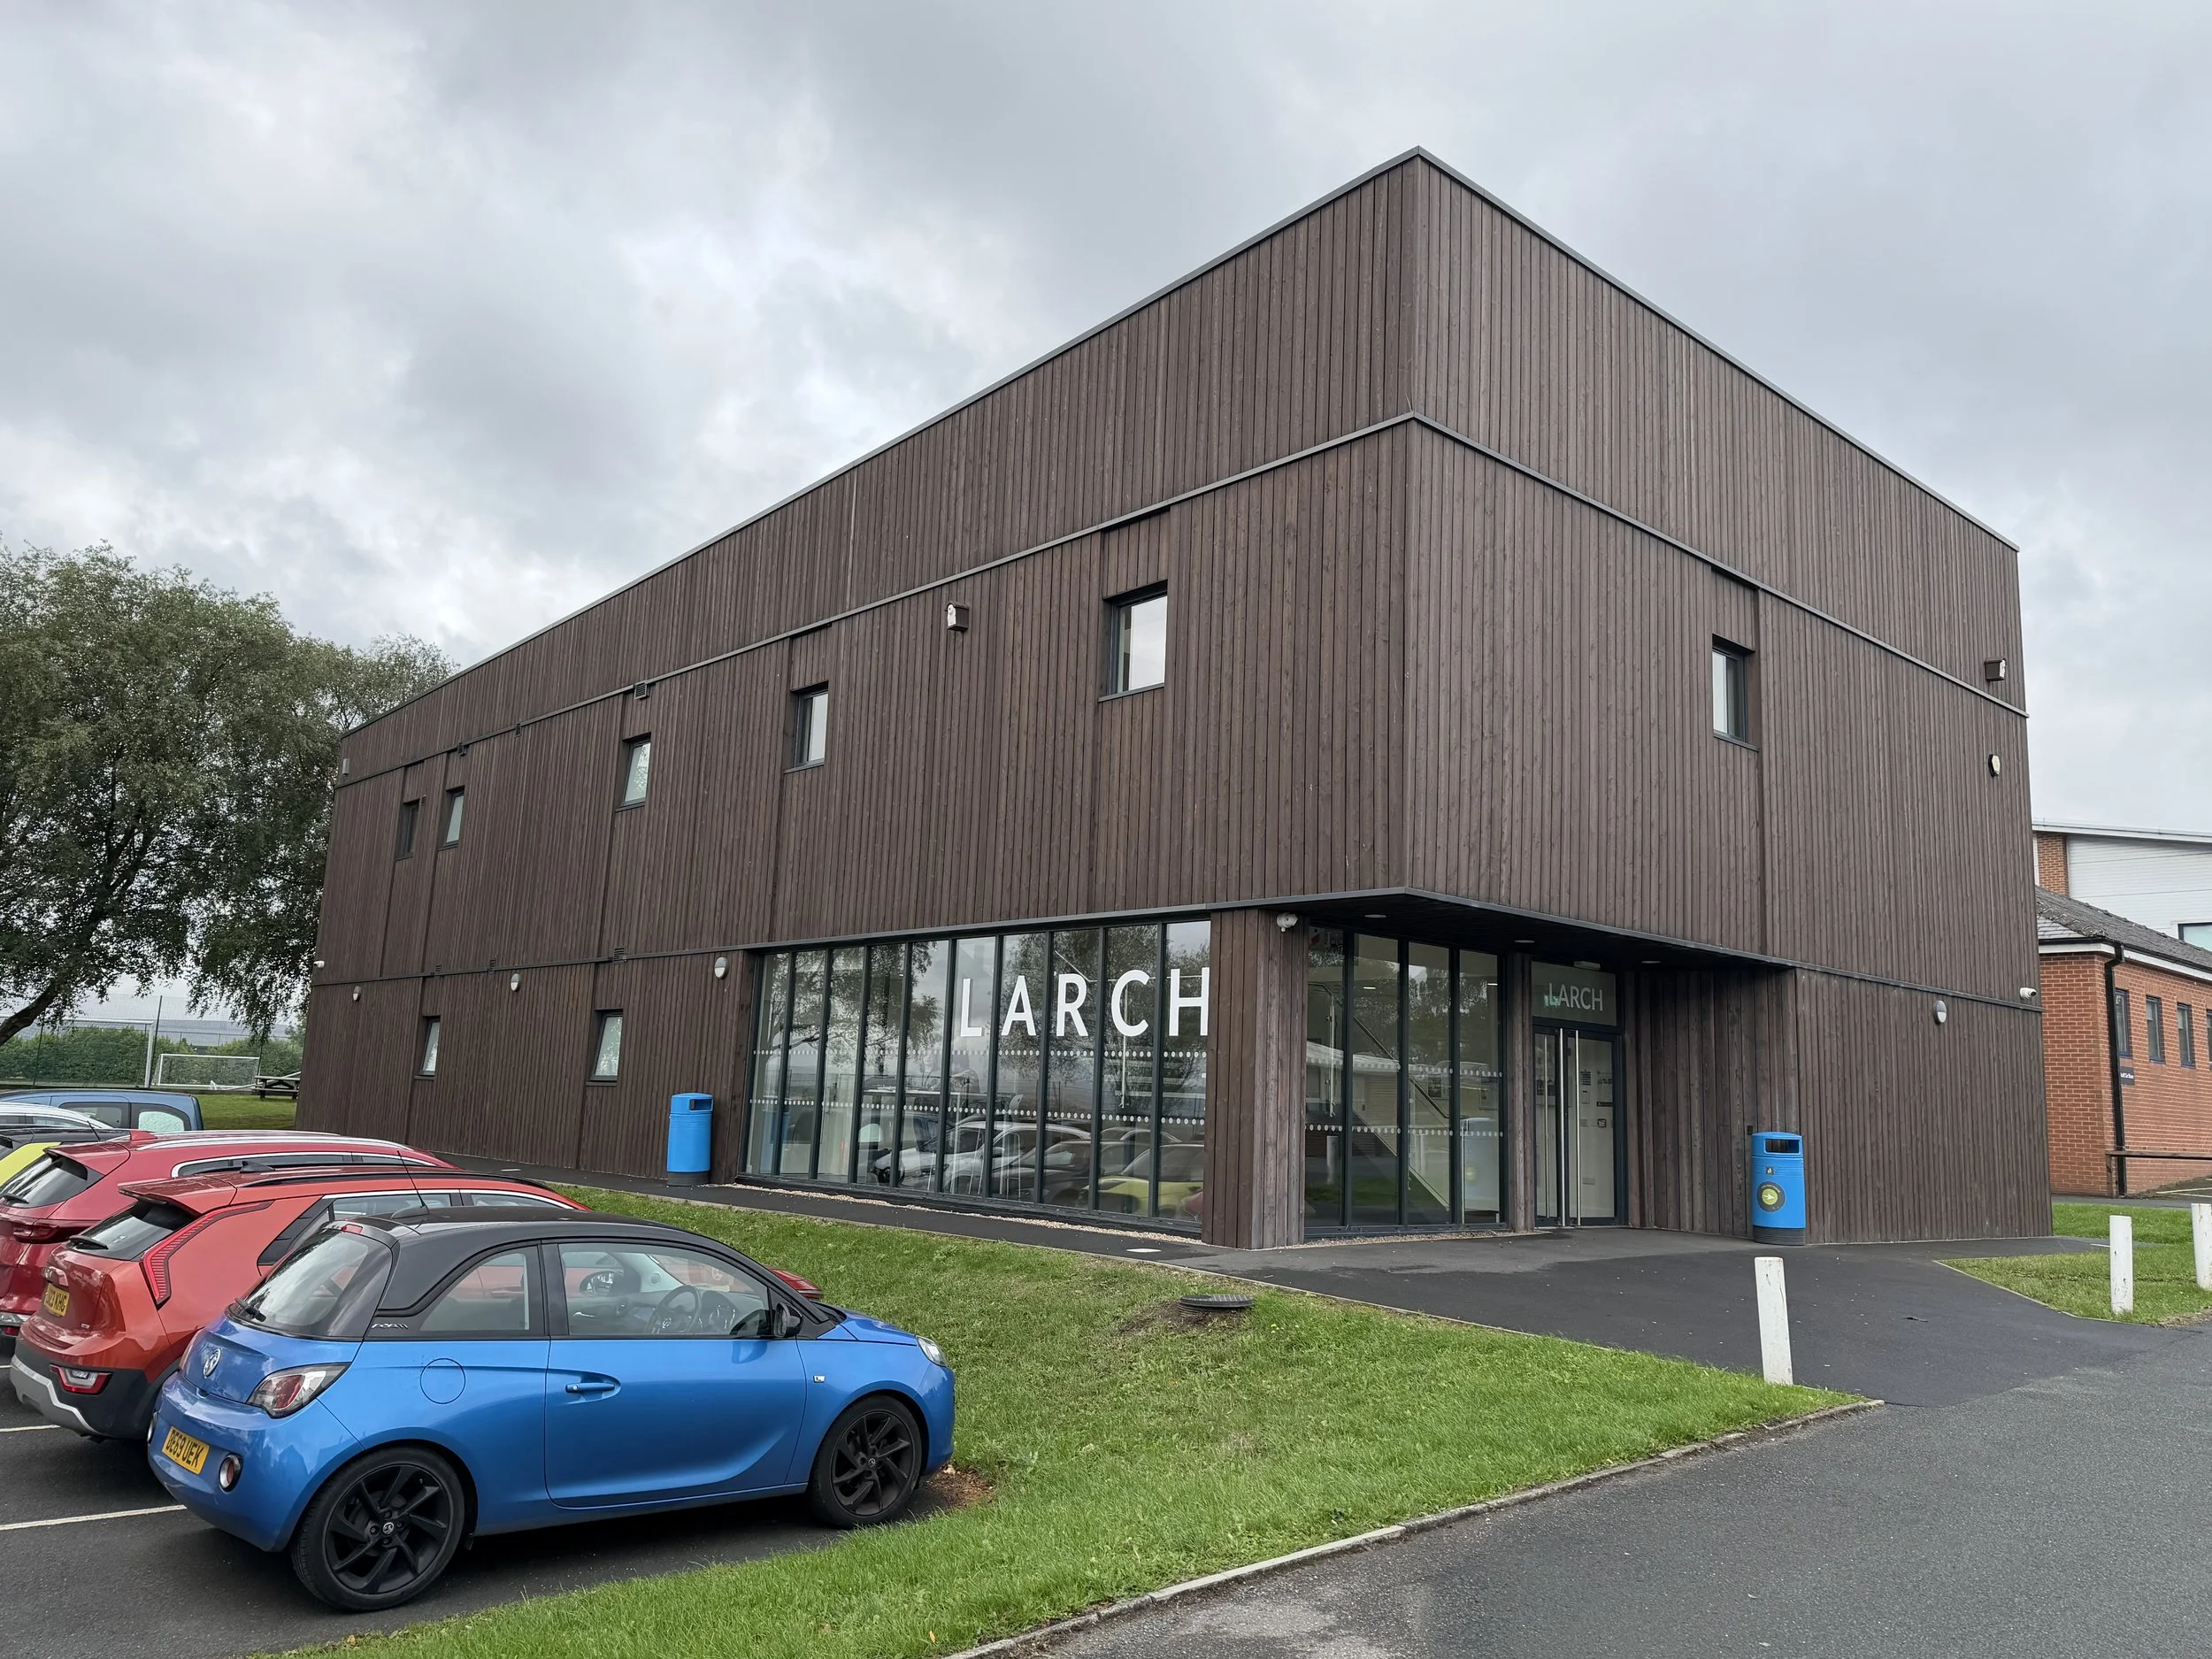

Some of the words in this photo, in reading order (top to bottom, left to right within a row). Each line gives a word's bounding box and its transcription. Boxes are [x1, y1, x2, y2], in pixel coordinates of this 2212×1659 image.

[960, 967, 1210, 1037] LARCH
[1549, 982, 1603, 1011] LARCH
[182, 1440, 204, 1469] UEK
